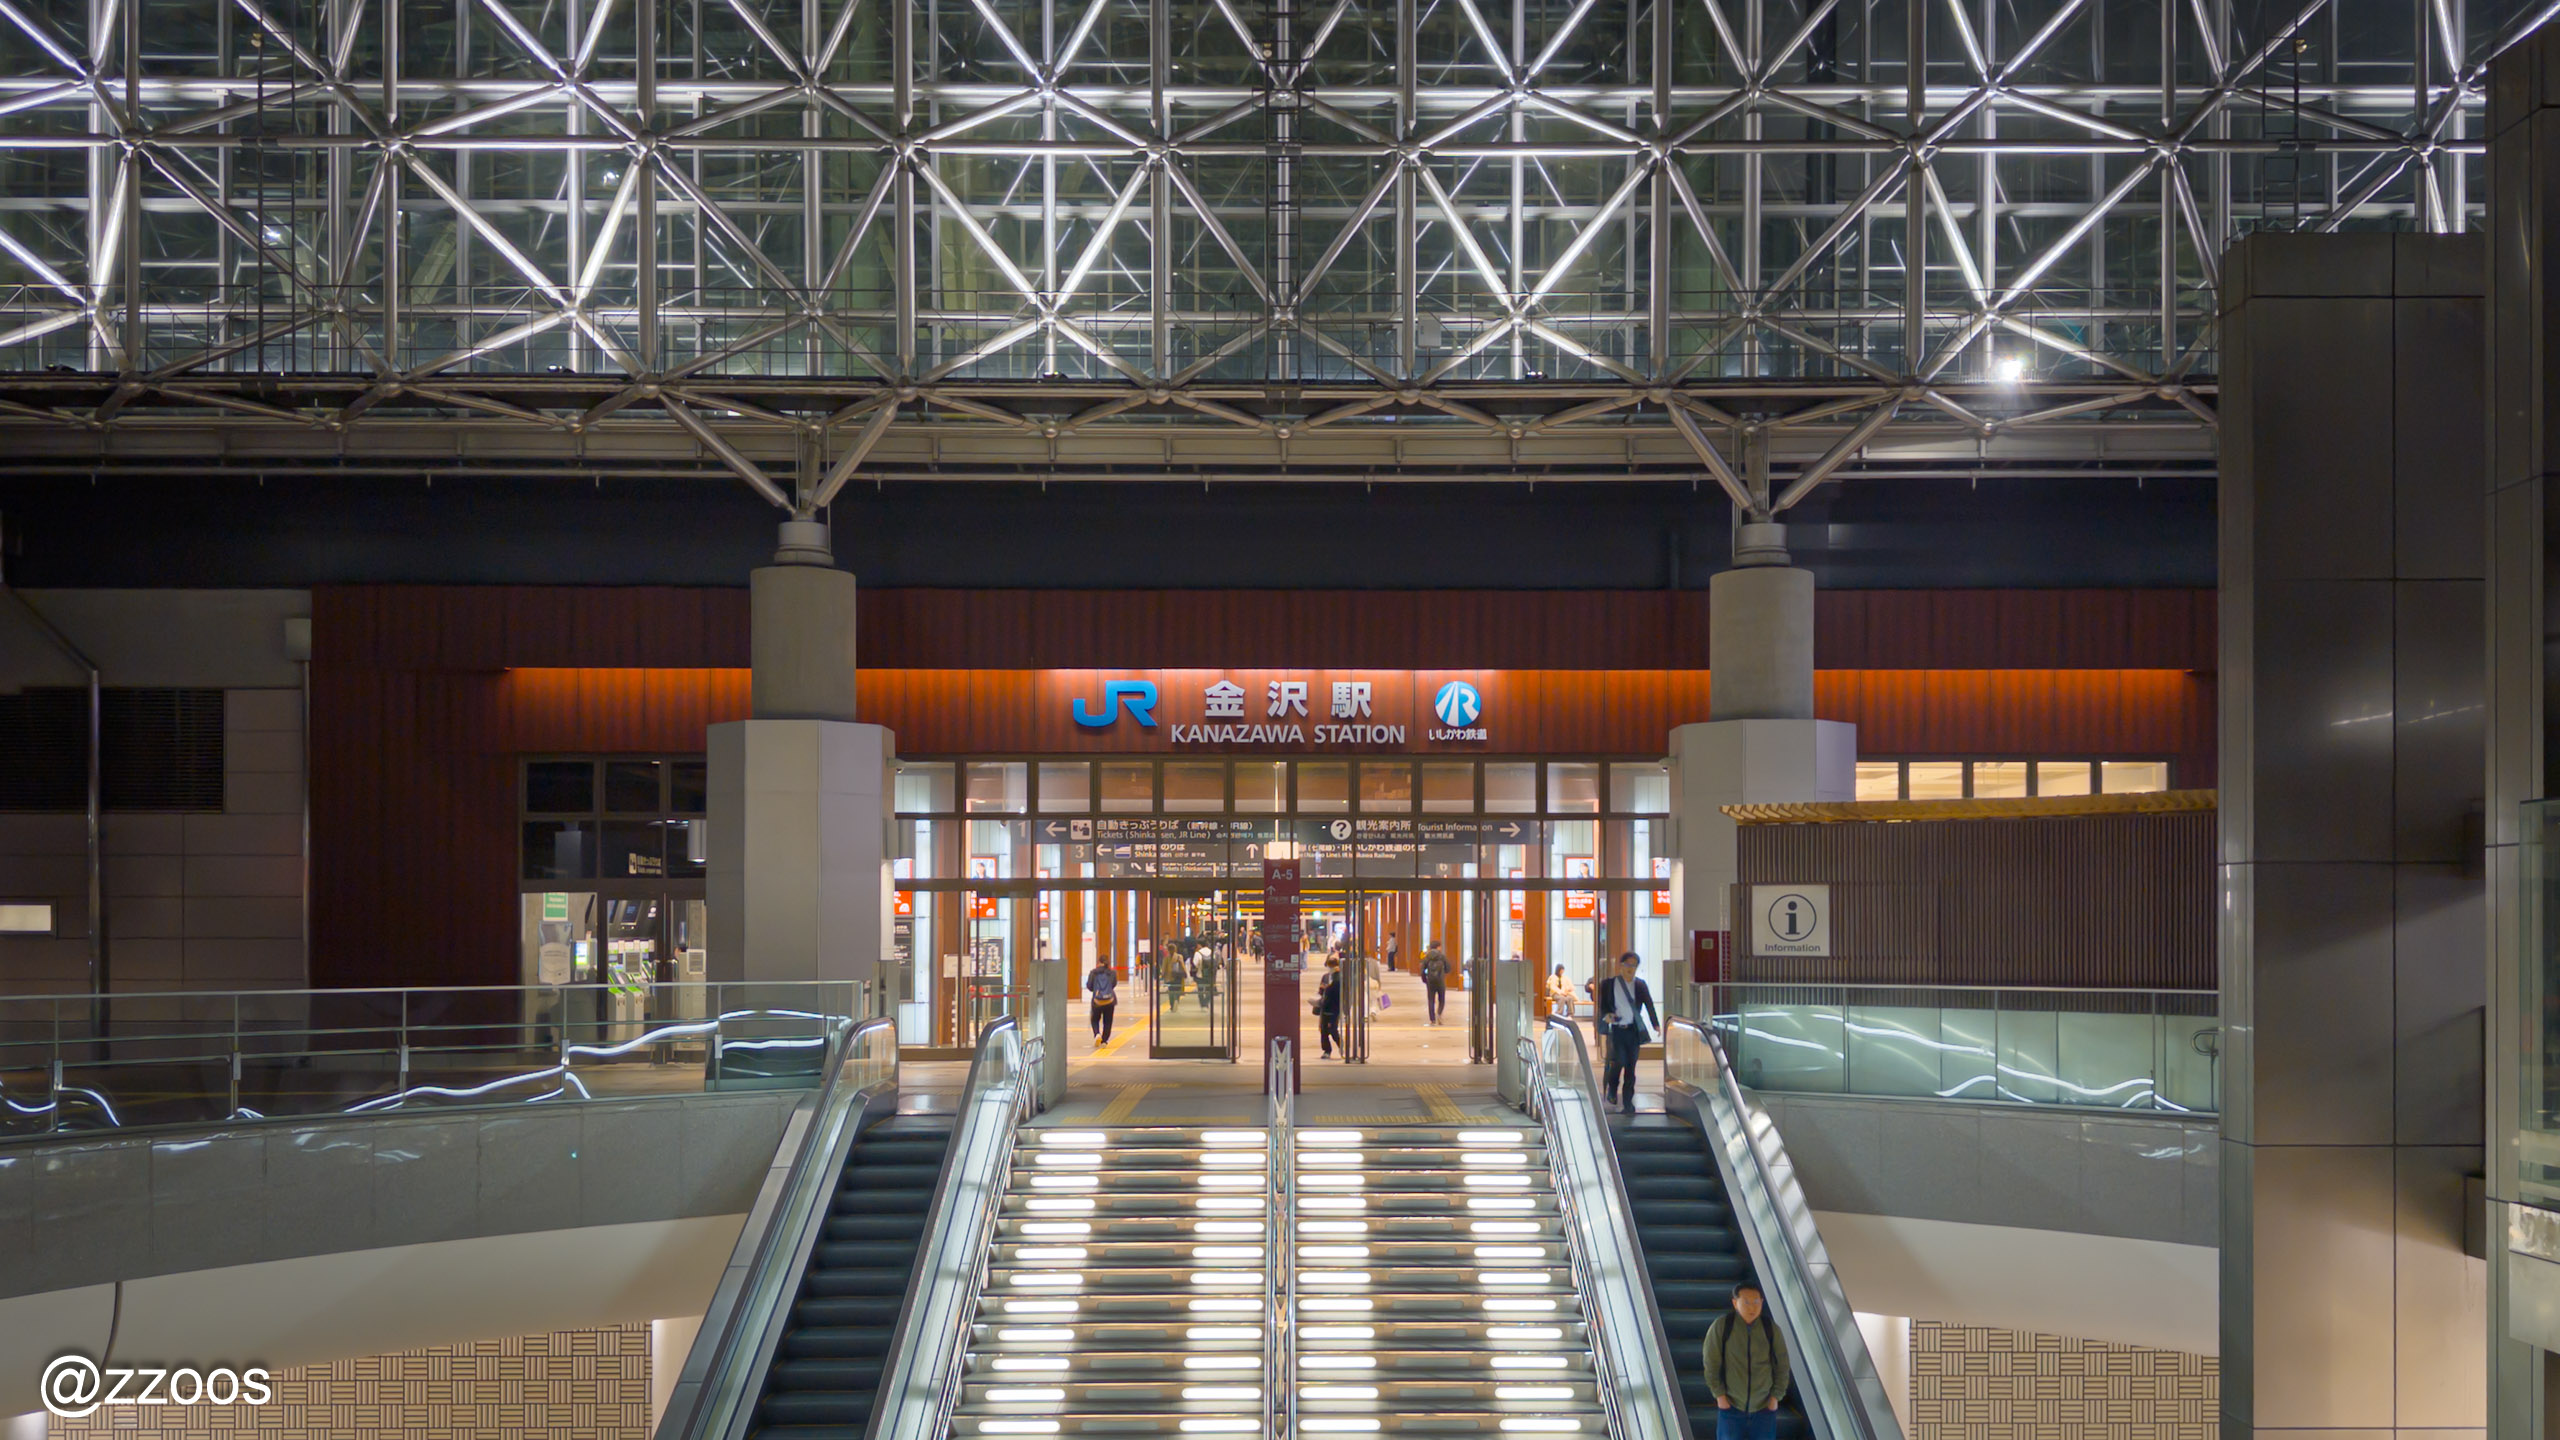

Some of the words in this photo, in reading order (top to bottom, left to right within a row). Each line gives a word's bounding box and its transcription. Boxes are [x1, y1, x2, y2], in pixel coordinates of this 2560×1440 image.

[1072, 680, 1158, 727] JR
[1204, 680, 1372, 719] 金沢駅
[1171, 724, 1305, 744] KANAZAWA
[1314, 724, 1405, 744] STATION
[1445, 822, 1493, 832] Informaon
[1097, 831, 1124, 839] Tickets
[1125, 831, 1177, 840] (Shinkasen,
[1271, 868, 1294, 881] A-5
[1764, 944, 1822, 952] Information
